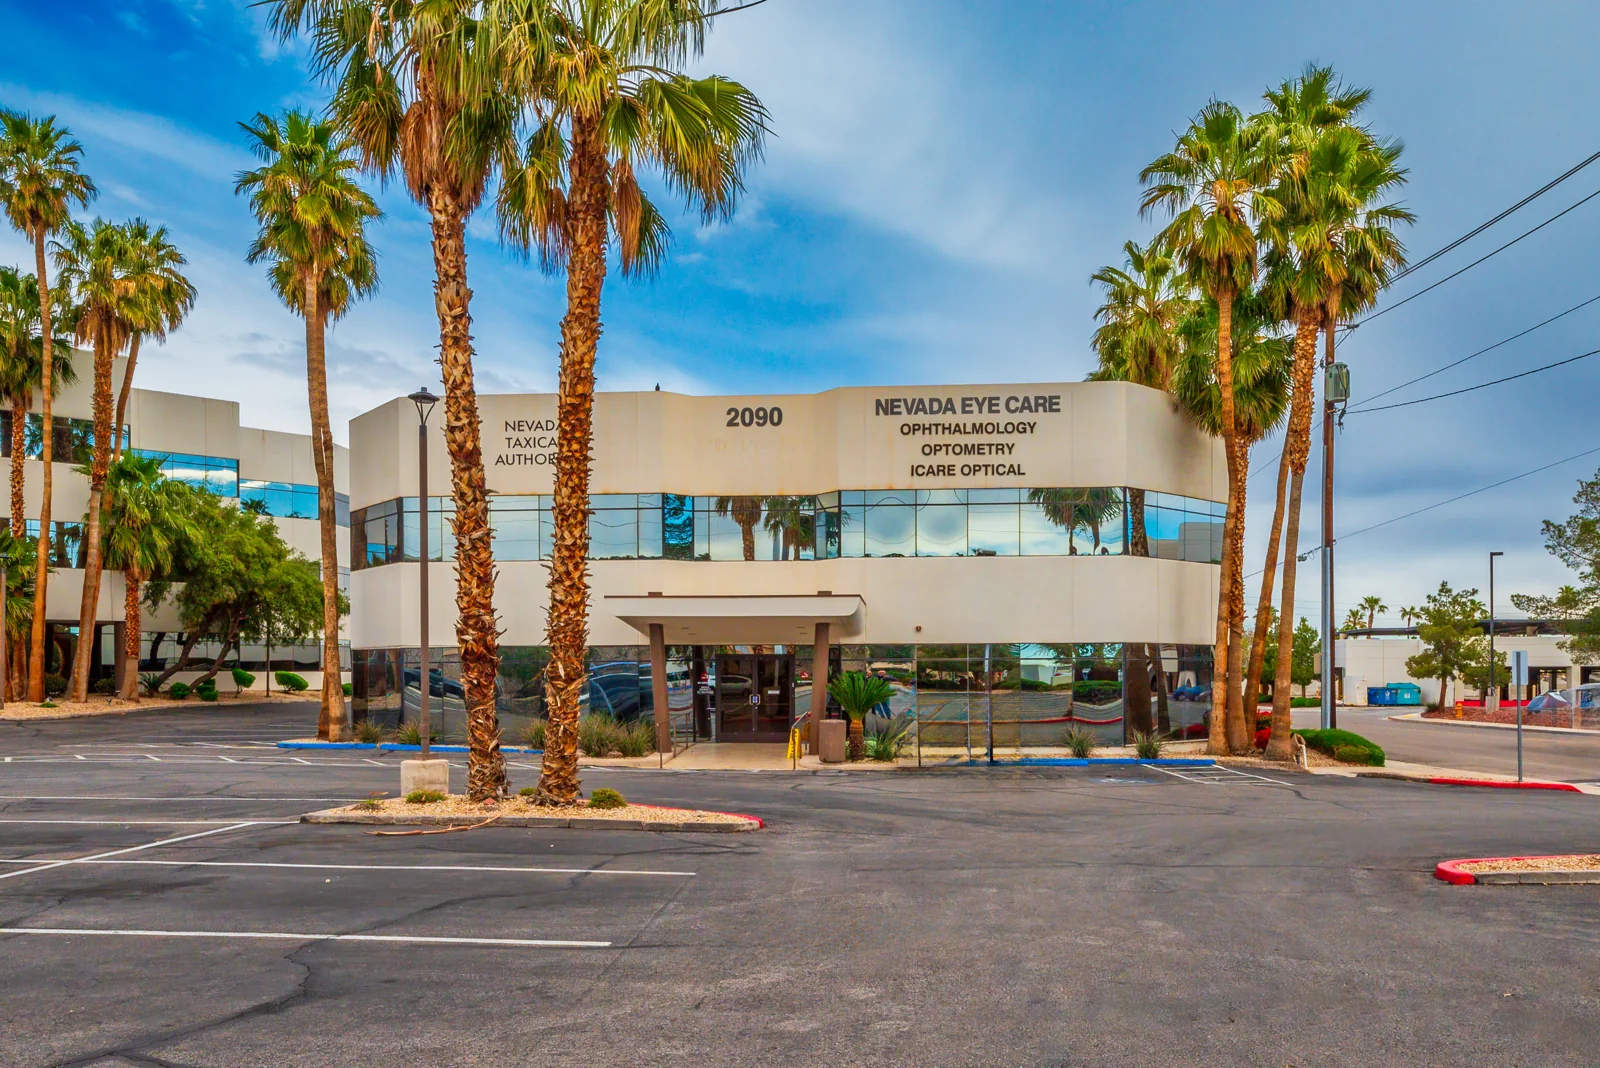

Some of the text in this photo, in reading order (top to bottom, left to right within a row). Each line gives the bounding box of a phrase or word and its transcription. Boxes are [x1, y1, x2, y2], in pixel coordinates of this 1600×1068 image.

[875, 395, 1061, 416] NEVADA EYE CARE
[726, 406, 783, 427] 2090
[900, 422, 1037, 435] OPHTHALMOLOGY
[921, 443, 1015, 456] OPTOMETRY
[911, 464, 1026, 477] ICARE OPTICAL
